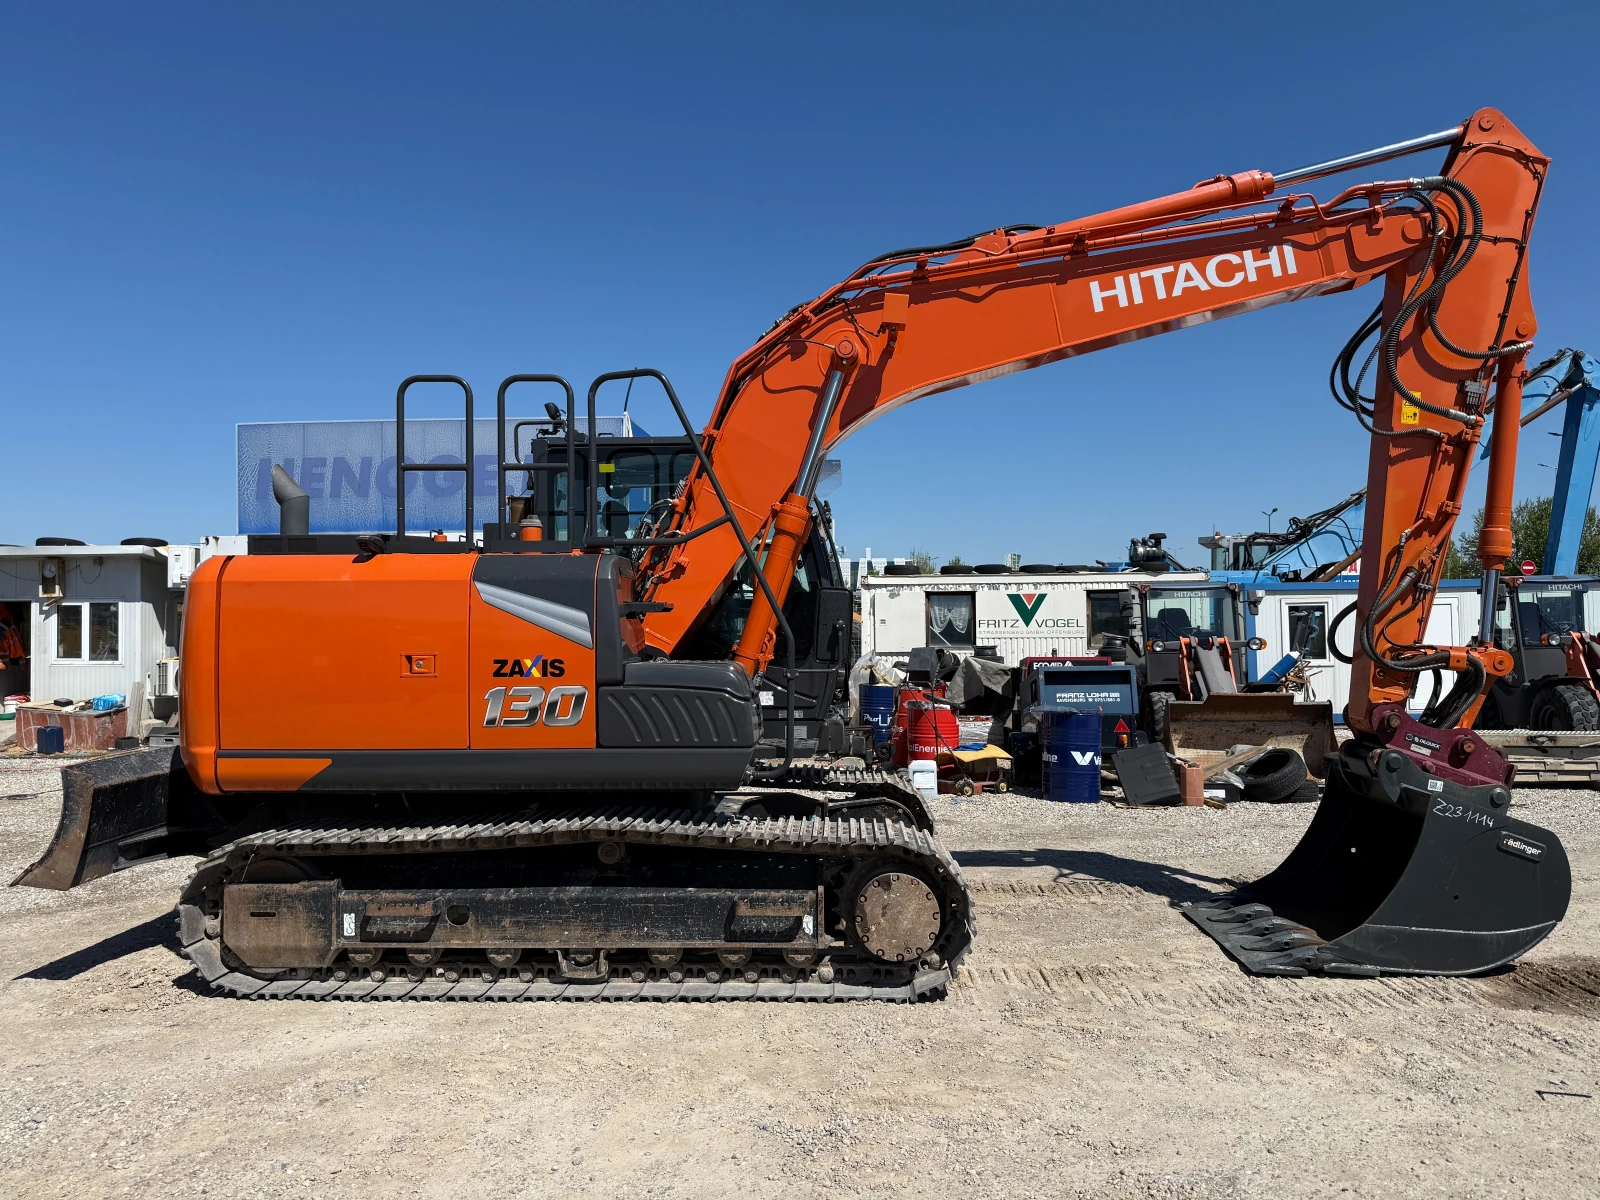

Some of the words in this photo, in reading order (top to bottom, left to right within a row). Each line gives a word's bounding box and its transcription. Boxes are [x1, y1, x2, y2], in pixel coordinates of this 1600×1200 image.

[1089, 242, 1297, 313] HITACHI
[1548, 583, 1583, 591] HITACHI
[978, 619, 1020, 628] FRITZ
[1035, 618, 1085, 628] VOGEL
[493, 654, 566, 678] ZAXIS
[482, 685, 589, 728] 130
[1503, 838, 1542, 856] rädlinger
